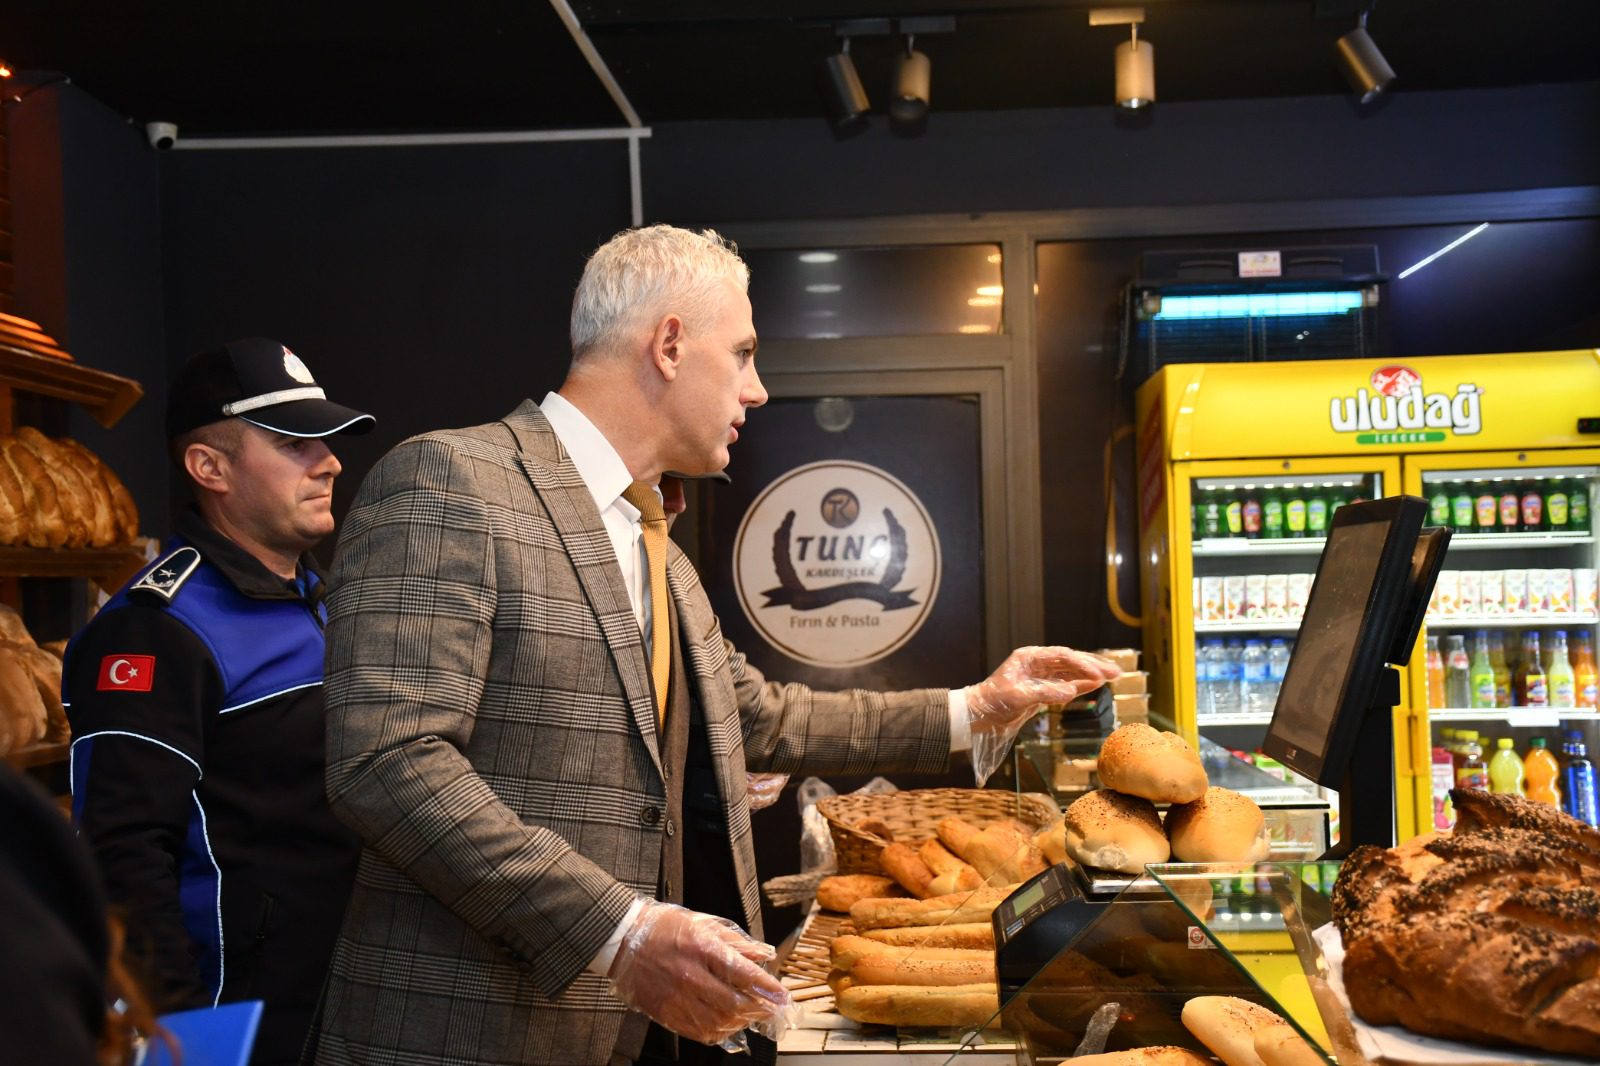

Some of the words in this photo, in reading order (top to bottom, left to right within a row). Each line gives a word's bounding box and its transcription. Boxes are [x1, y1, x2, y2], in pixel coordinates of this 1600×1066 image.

[1330, 384, 1482, 436] uludağ
[825, 616, 836, 628] &
[841, 614, 880, 627] Pasta
